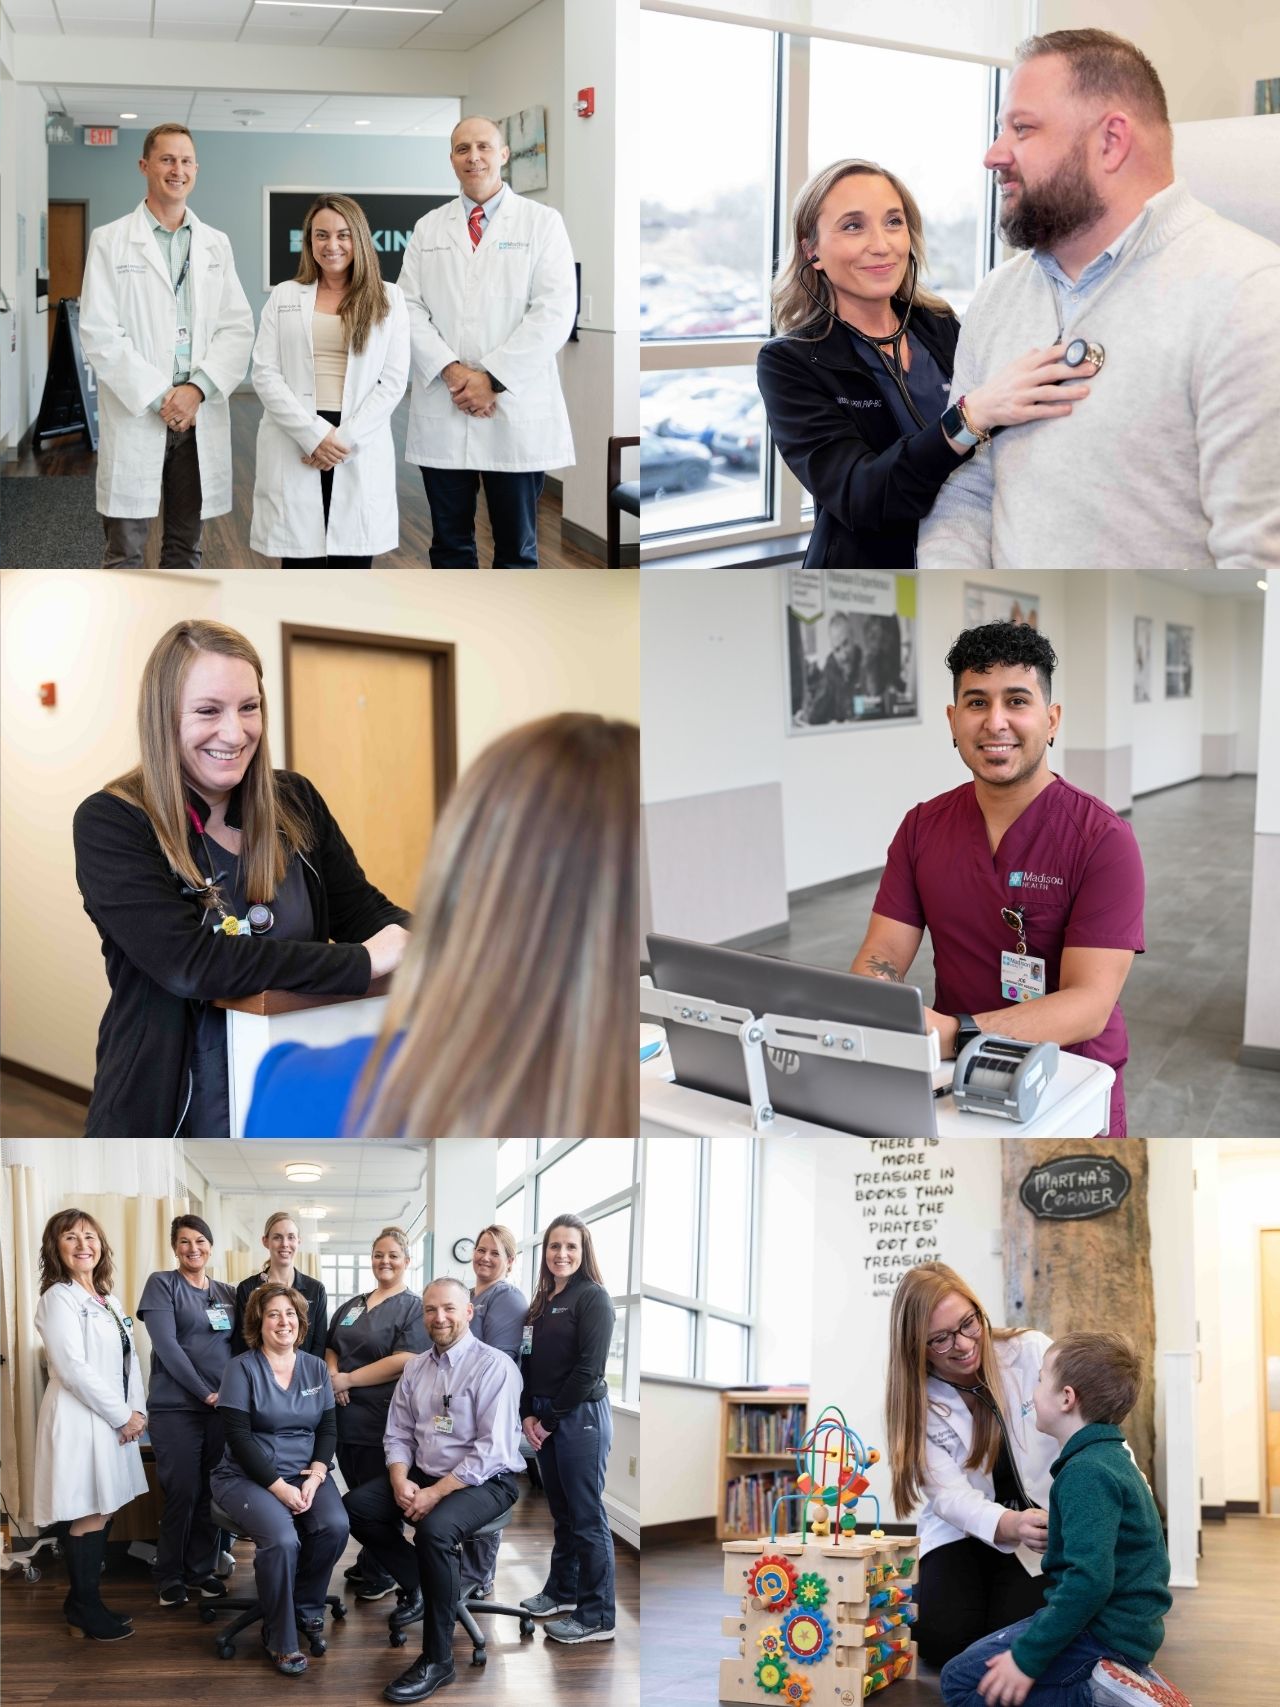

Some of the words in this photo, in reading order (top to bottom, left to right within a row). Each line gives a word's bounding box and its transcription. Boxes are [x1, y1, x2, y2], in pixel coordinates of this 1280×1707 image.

[90, 128, 113, 145] EXIT
[1022, 881, 1049, 891] HEALTH
[1023, 871, 1064, 886] Madison
[1010, 957, 1031, 968] Madison
[870, 1138, 915, 1152] THERE
[924, 1138, 939, 1147] IS
[881, 1153, 926, 1166] MORE
[854, 1168, 932, 1186] TREASURE
[940, 1166, 955, 1179] IN
[1034, 1165, 1111, 1193] MARTHA'S
[855, 1187, 908, 1201] BOOKS
[916, 1184, 954, 1199] THAN
[1041, 1187, 1117, 1212] CORNER
[862, 1205, 877, 1217] IN
[884, 1204, 908, 1216] ALL
[917, 1202, 945, 1216] THE
[869, 1219, 938, 1234] PIRATES'
[916, 1236, 938, 1248] ON
